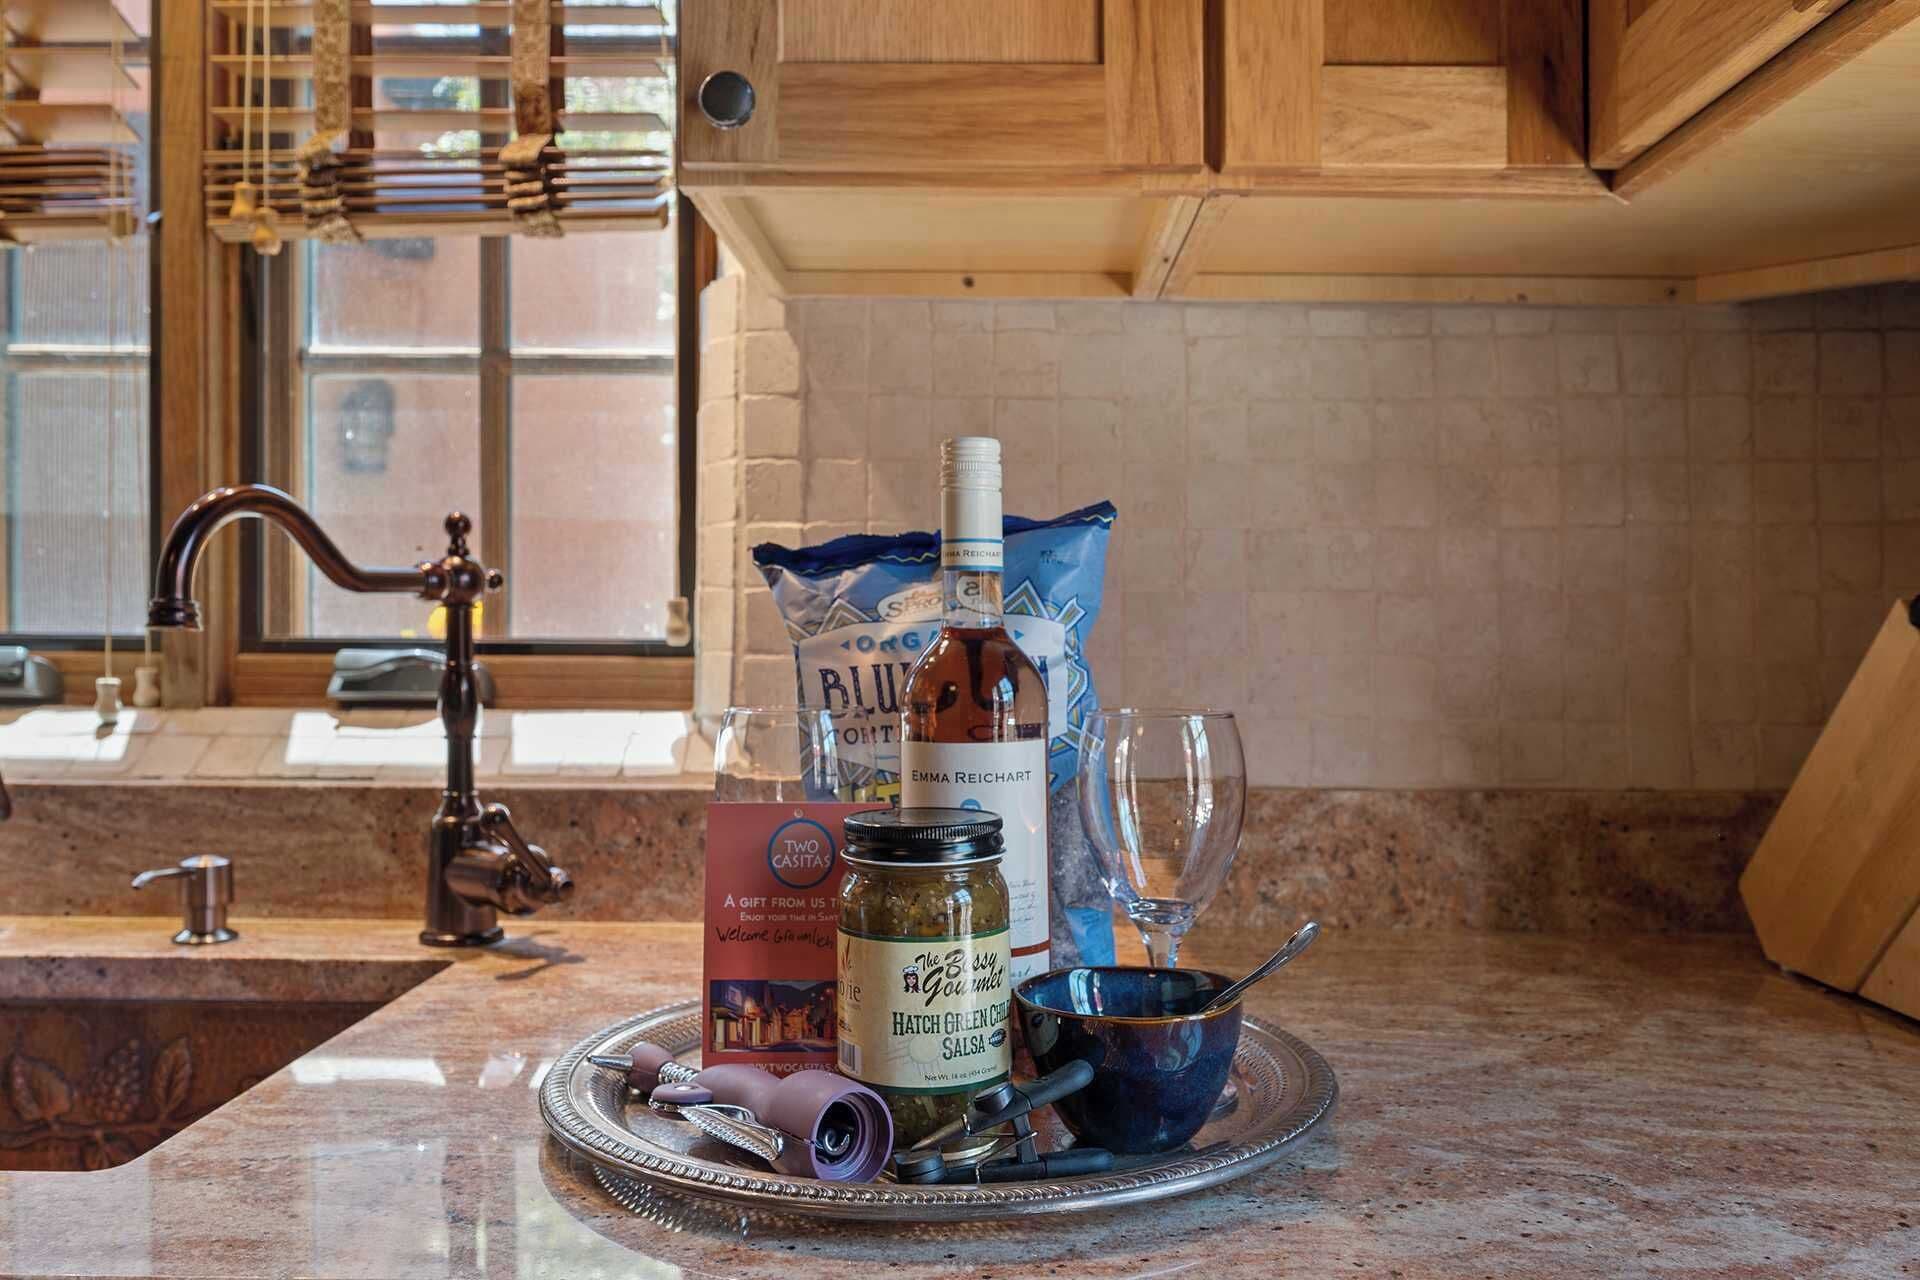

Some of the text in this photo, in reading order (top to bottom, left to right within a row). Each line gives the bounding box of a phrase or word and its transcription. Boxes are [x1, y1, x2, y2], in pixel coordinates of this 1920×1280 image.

[818, 662, 912, 719] BLU
[912, 770, 1032, 784] EMMA REICHART
[784, 839, 819, 853] TWO
[772, 855, 831, 869] CASITAS
[724, 894, 735, 908] A
[740, 897, 766, 908] GIFT
[772, 897, 806, 908] FROM
[811, 897, 825, 908] US
[740, 912, 766, 921] ENJOY
[716, 925, 769, 942] Welcome
[915, 952, 940, 971] The
[893, 1012, 940, 1036] HATCH
[944, 1008, 988, 1036] GREEN
[943, 1034, 985, 1060] SALSA
